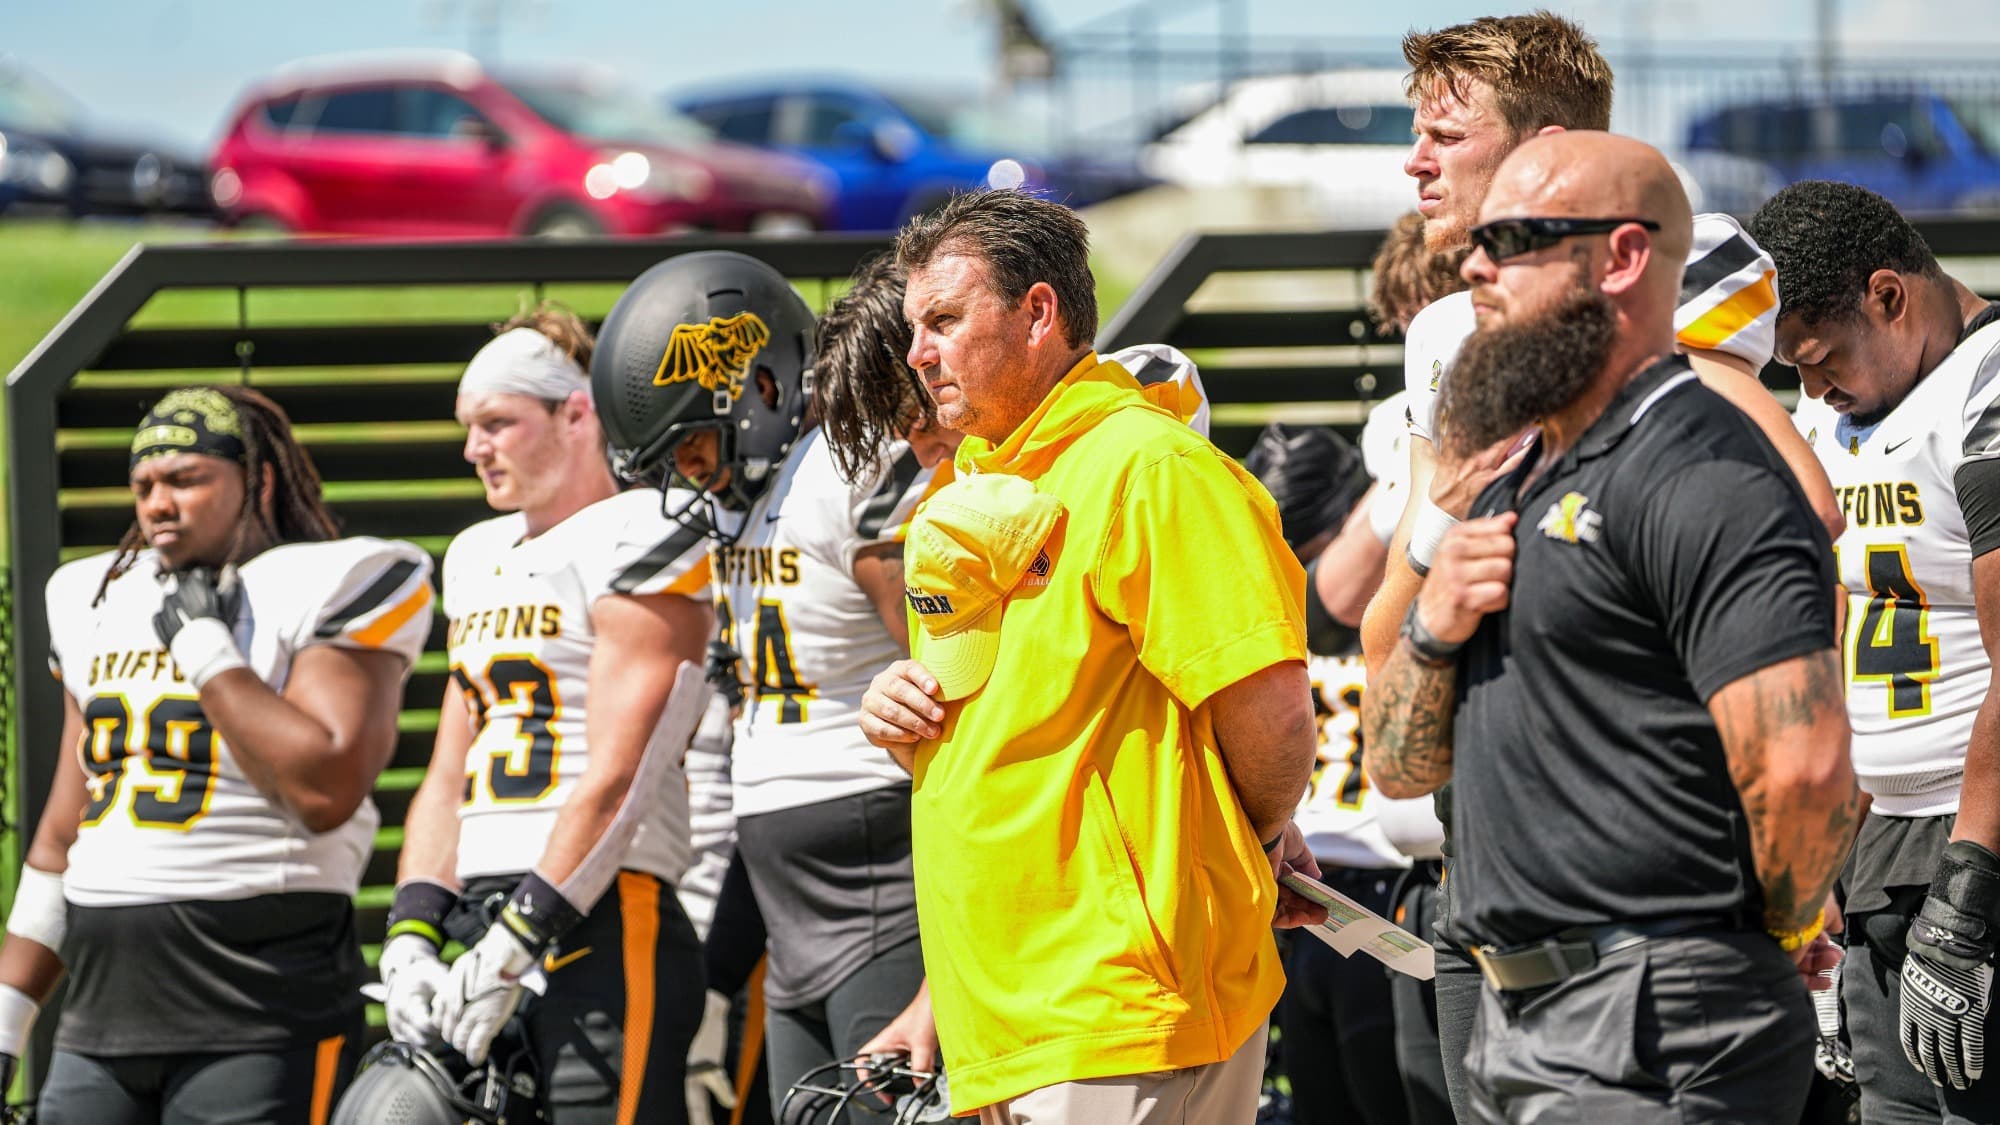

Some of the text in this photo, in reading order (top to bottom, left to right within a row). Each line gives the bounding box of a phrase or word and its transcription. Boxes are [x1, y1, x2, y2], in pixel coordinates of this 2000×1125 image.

[1833, 482, 1925, 528] FONS
[449, 604, 562, 649] IFFONS
[1834, 544, 1940, 718] 4
[78, 692, 220, 834] 99
[1903, 958, 1962, 1011] BATTLE
